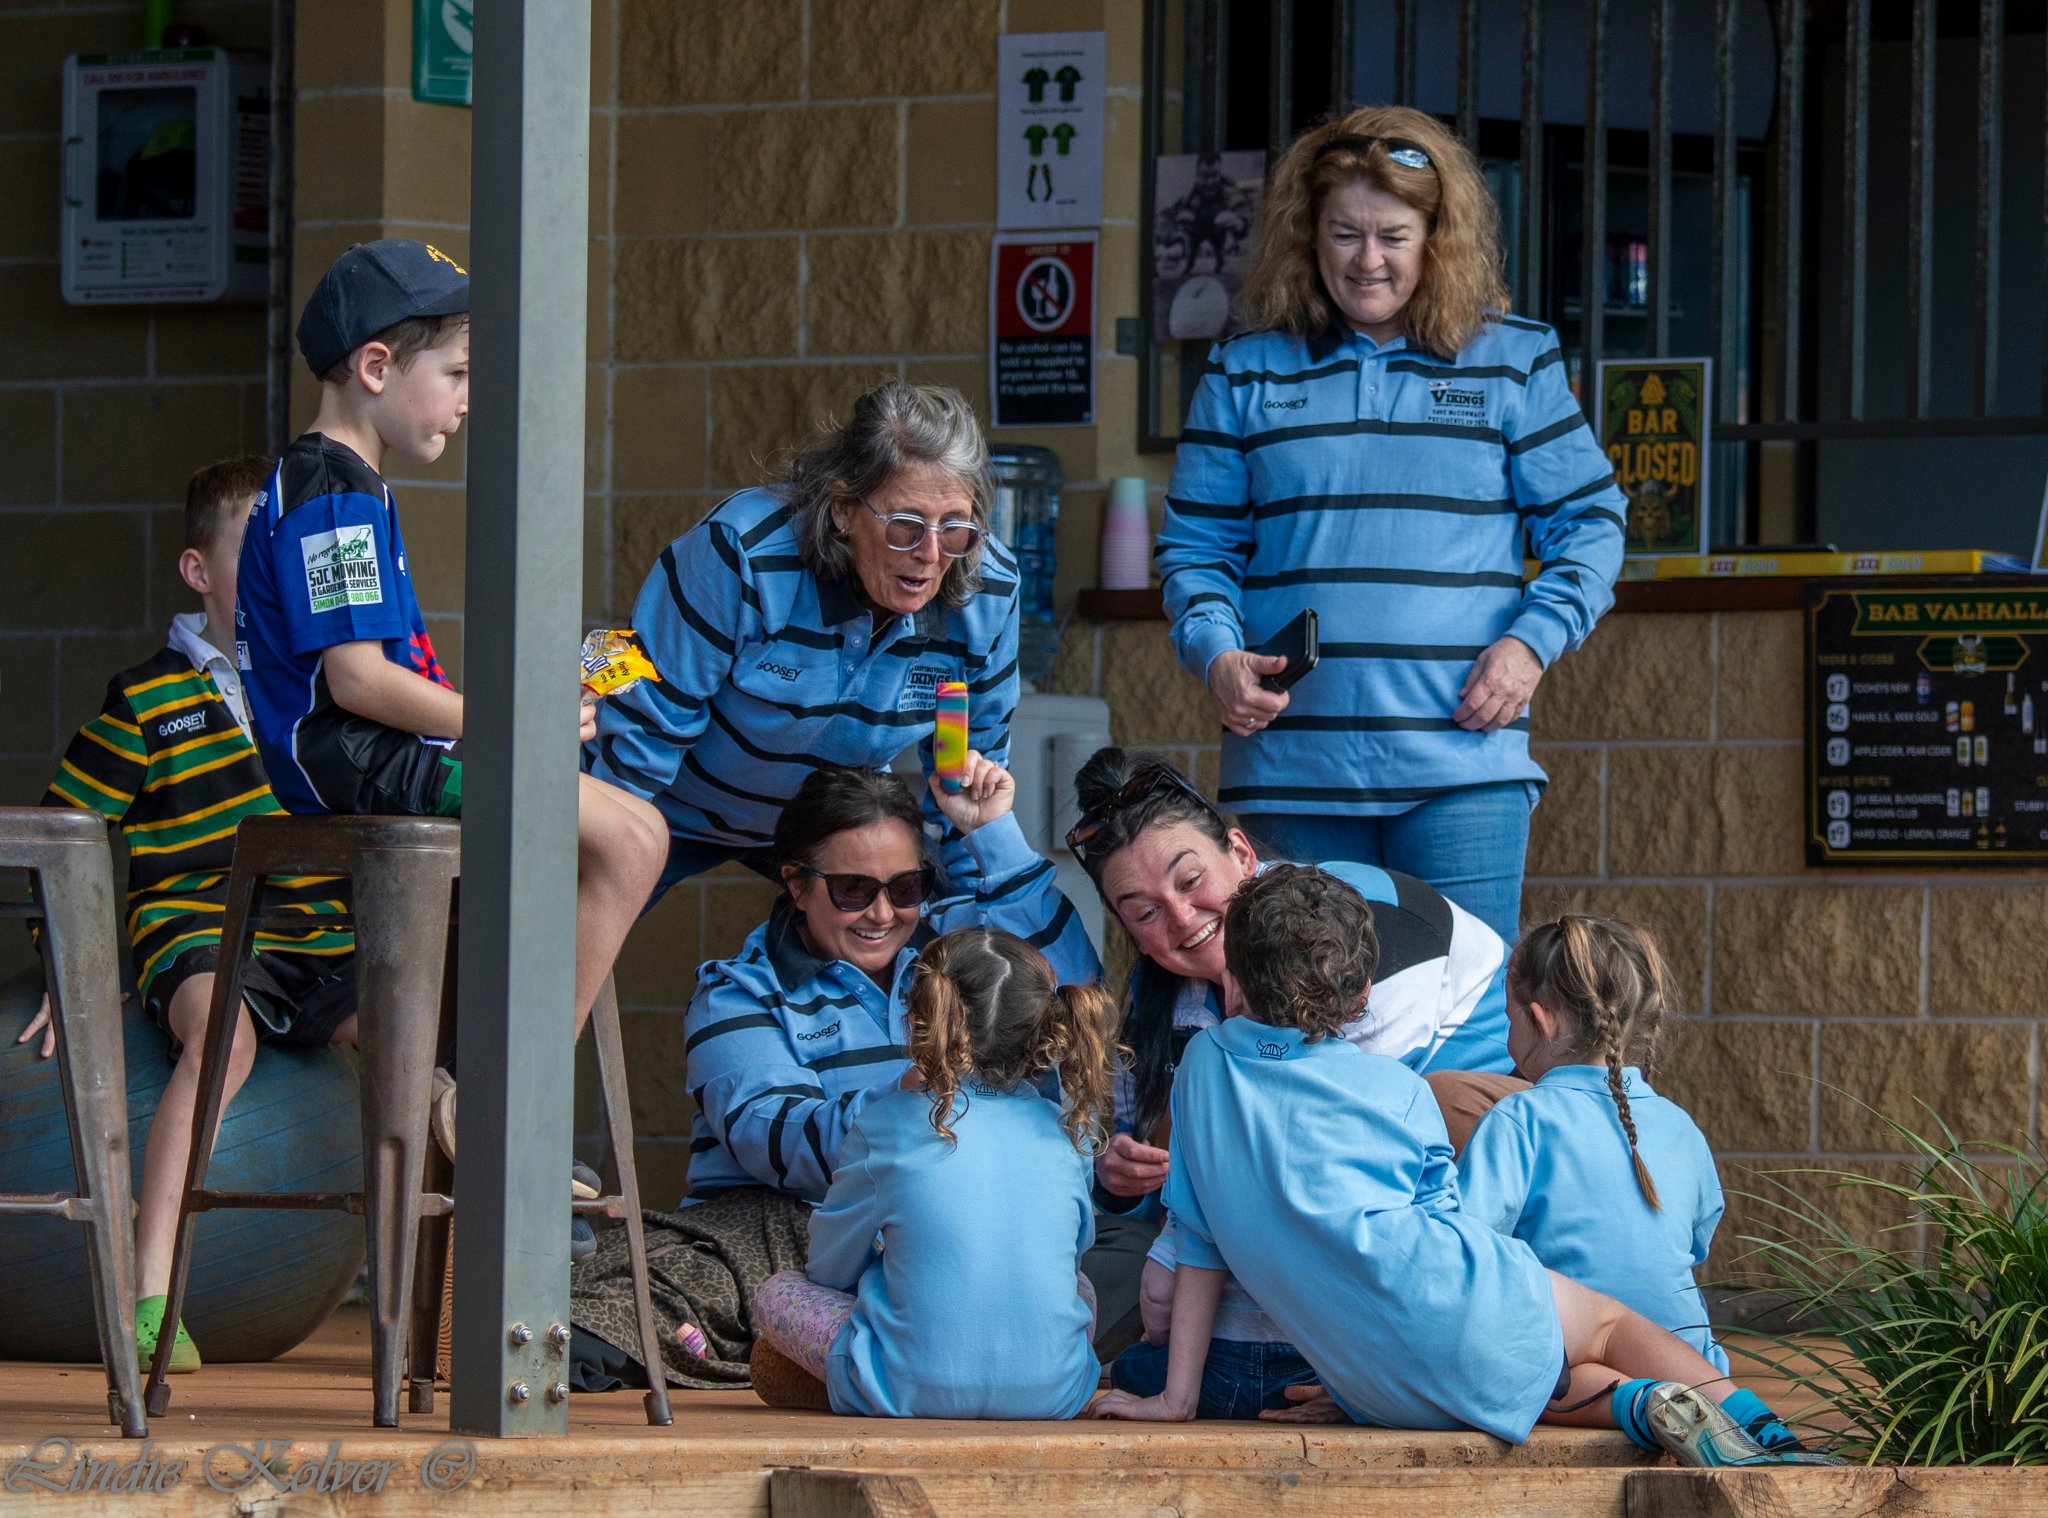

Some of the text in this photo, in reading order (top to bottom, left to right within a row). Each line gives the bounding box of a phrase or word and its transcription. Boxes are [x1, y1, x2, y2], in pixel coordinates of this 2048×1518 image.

[1025, 245, 1071, 256] UNDER 18
[1000, 341, 1083, 353] No alcohol can be
[1000, 355, 1085, 370] sold or supplied to
[1000, 371, 1033, 383] anyone
[1035, 369, 1063, 380] under
[1015, 384, 1049, 397] against
[1050, 383, 1067, 394] the
[1430, 389, 1485, 405] VIKINGS
[1263, 396, 1308, 410] GOOSEY
[1627, 408, 1678, 434] BAR
[1608, 441, 1696, 487] CLOSED
[332, 560, 376, 583] MOWING
[318, 579, 349, 595] GARDENING
[349, 578, 378, 589] SERVICES
[313, 596, 335, 610] SIMON
[1868, 601, 2048, 622] BAR VALHALL
[756, 661, 802, 682] GOOSEY
[909, 672, 952, 686] IKINGS
[1890, 682, 1911, 694] NEW
[158, 710, 206, 736] GOOSEY
[1915, 711, 1939, 722] GOLD
[1853, 745, 1878, 757] APPLE
[1906, 745, 1927, 756] PEAR
[1928, 745, 1952, 756] CIDER
[2014, 800, 2046, 812] STUBBY
[1853, 809, 1919, 819] CANADIAN CLUB
[1853, 830, 1876, 840] HARD
[1877, 829, 1898, 840] SOLO
[1936, 829, 1971, 840] ORANGE
[796, 1020, 841, 1041] GOOSEY
